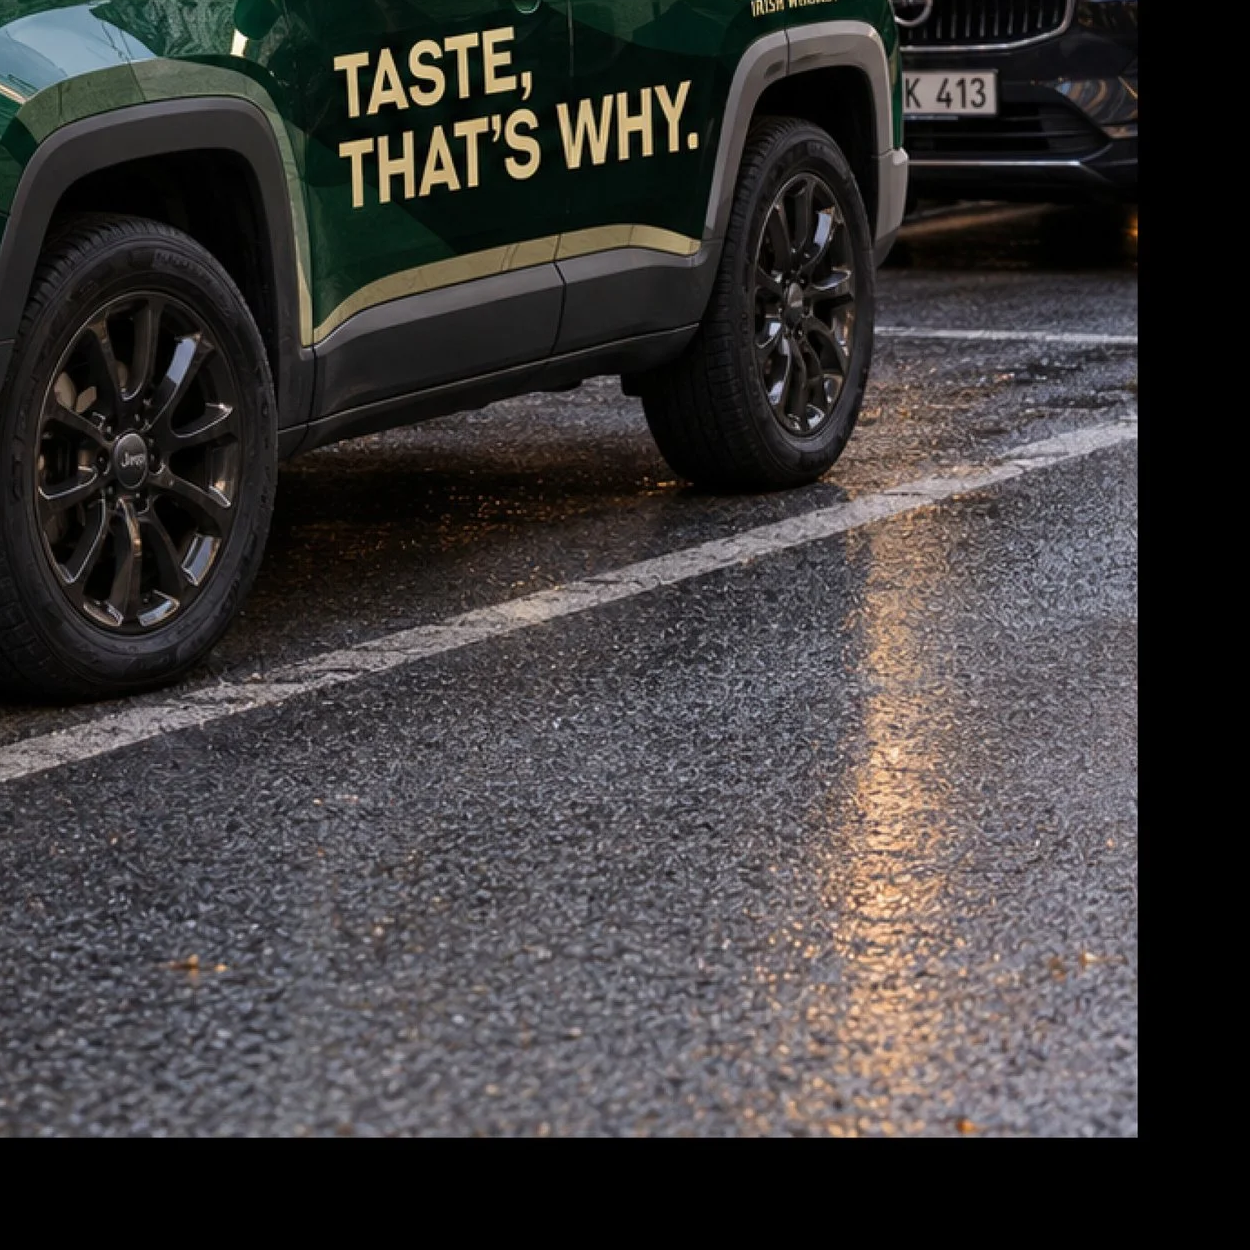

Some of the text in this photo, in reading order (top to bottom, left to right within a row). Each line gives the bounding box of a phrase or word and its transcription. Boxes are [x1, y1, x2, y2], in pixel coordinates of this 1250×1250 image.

[333, 26, 533, 119] TASTE,
[935, 77, 987, 109] 413
[338, 79, 700, 209] THAT'S WHY.
